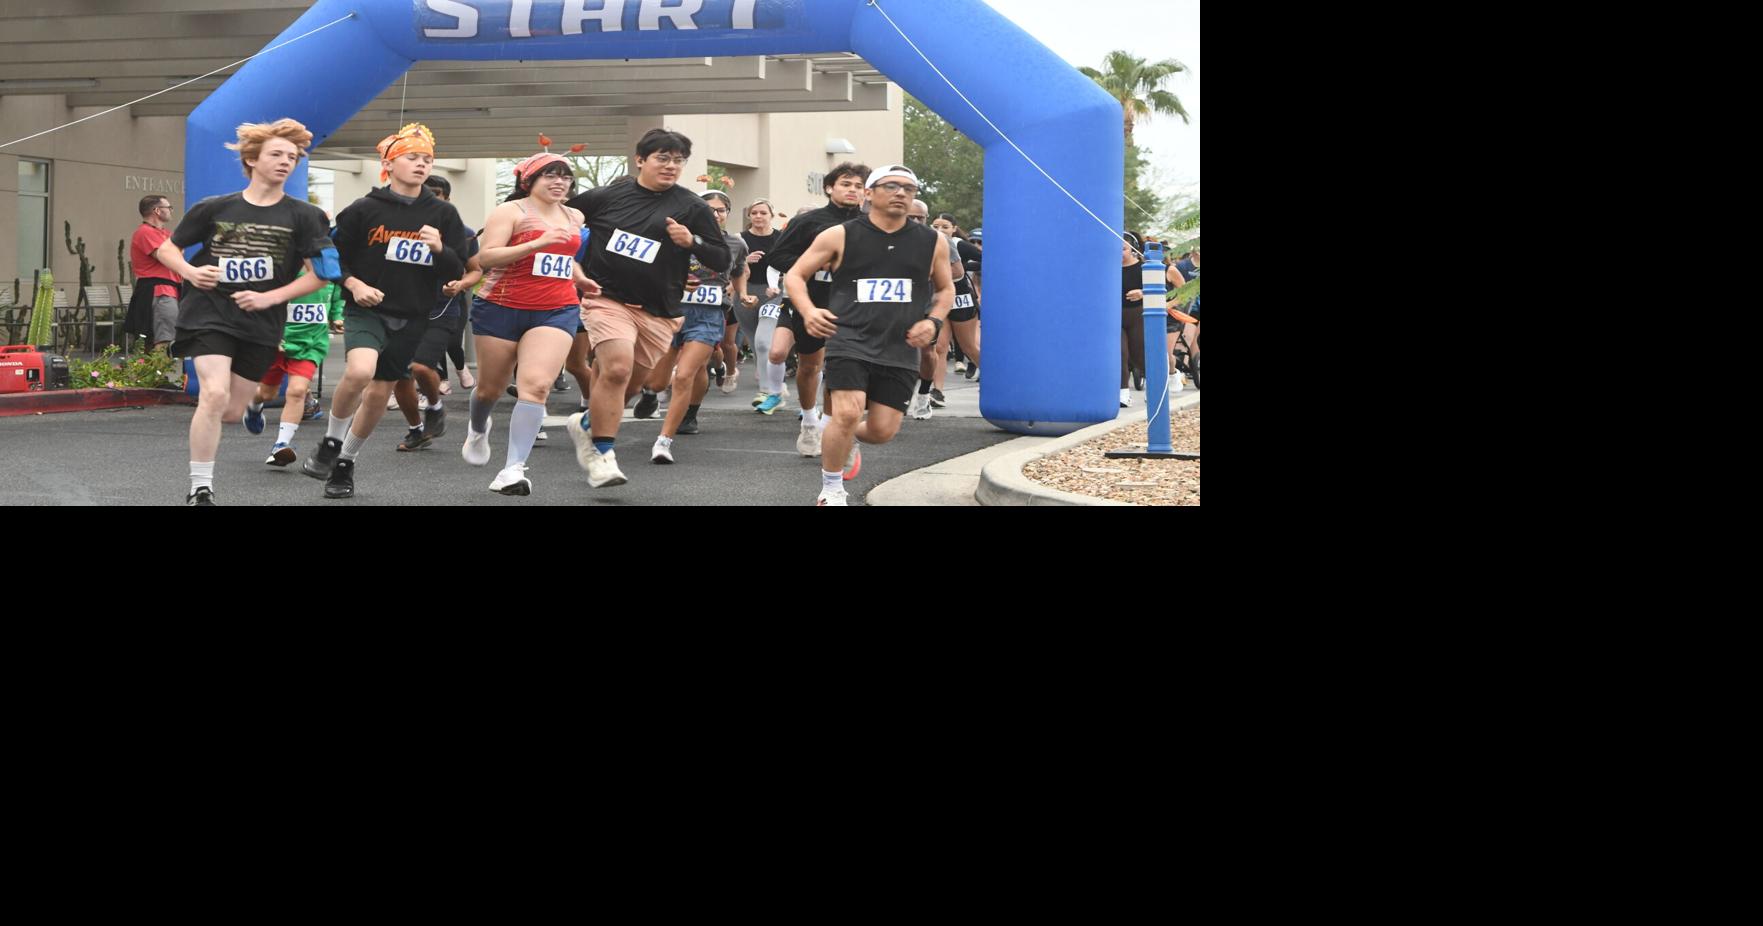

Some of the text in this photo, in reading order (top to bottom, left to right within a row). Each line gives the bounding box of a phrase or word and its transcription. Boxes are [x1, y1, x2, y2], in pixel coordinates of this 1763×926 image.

[423, 0, 755, 38] START
[614, 233, 654, 259] 647
[226, 259, 267, 281] 666
[541, 254, 572, 277] 646
[866, 280, 906, 301] 724
[951, 295, 970, 308] 04
[292, 304, 324, 322] 658
